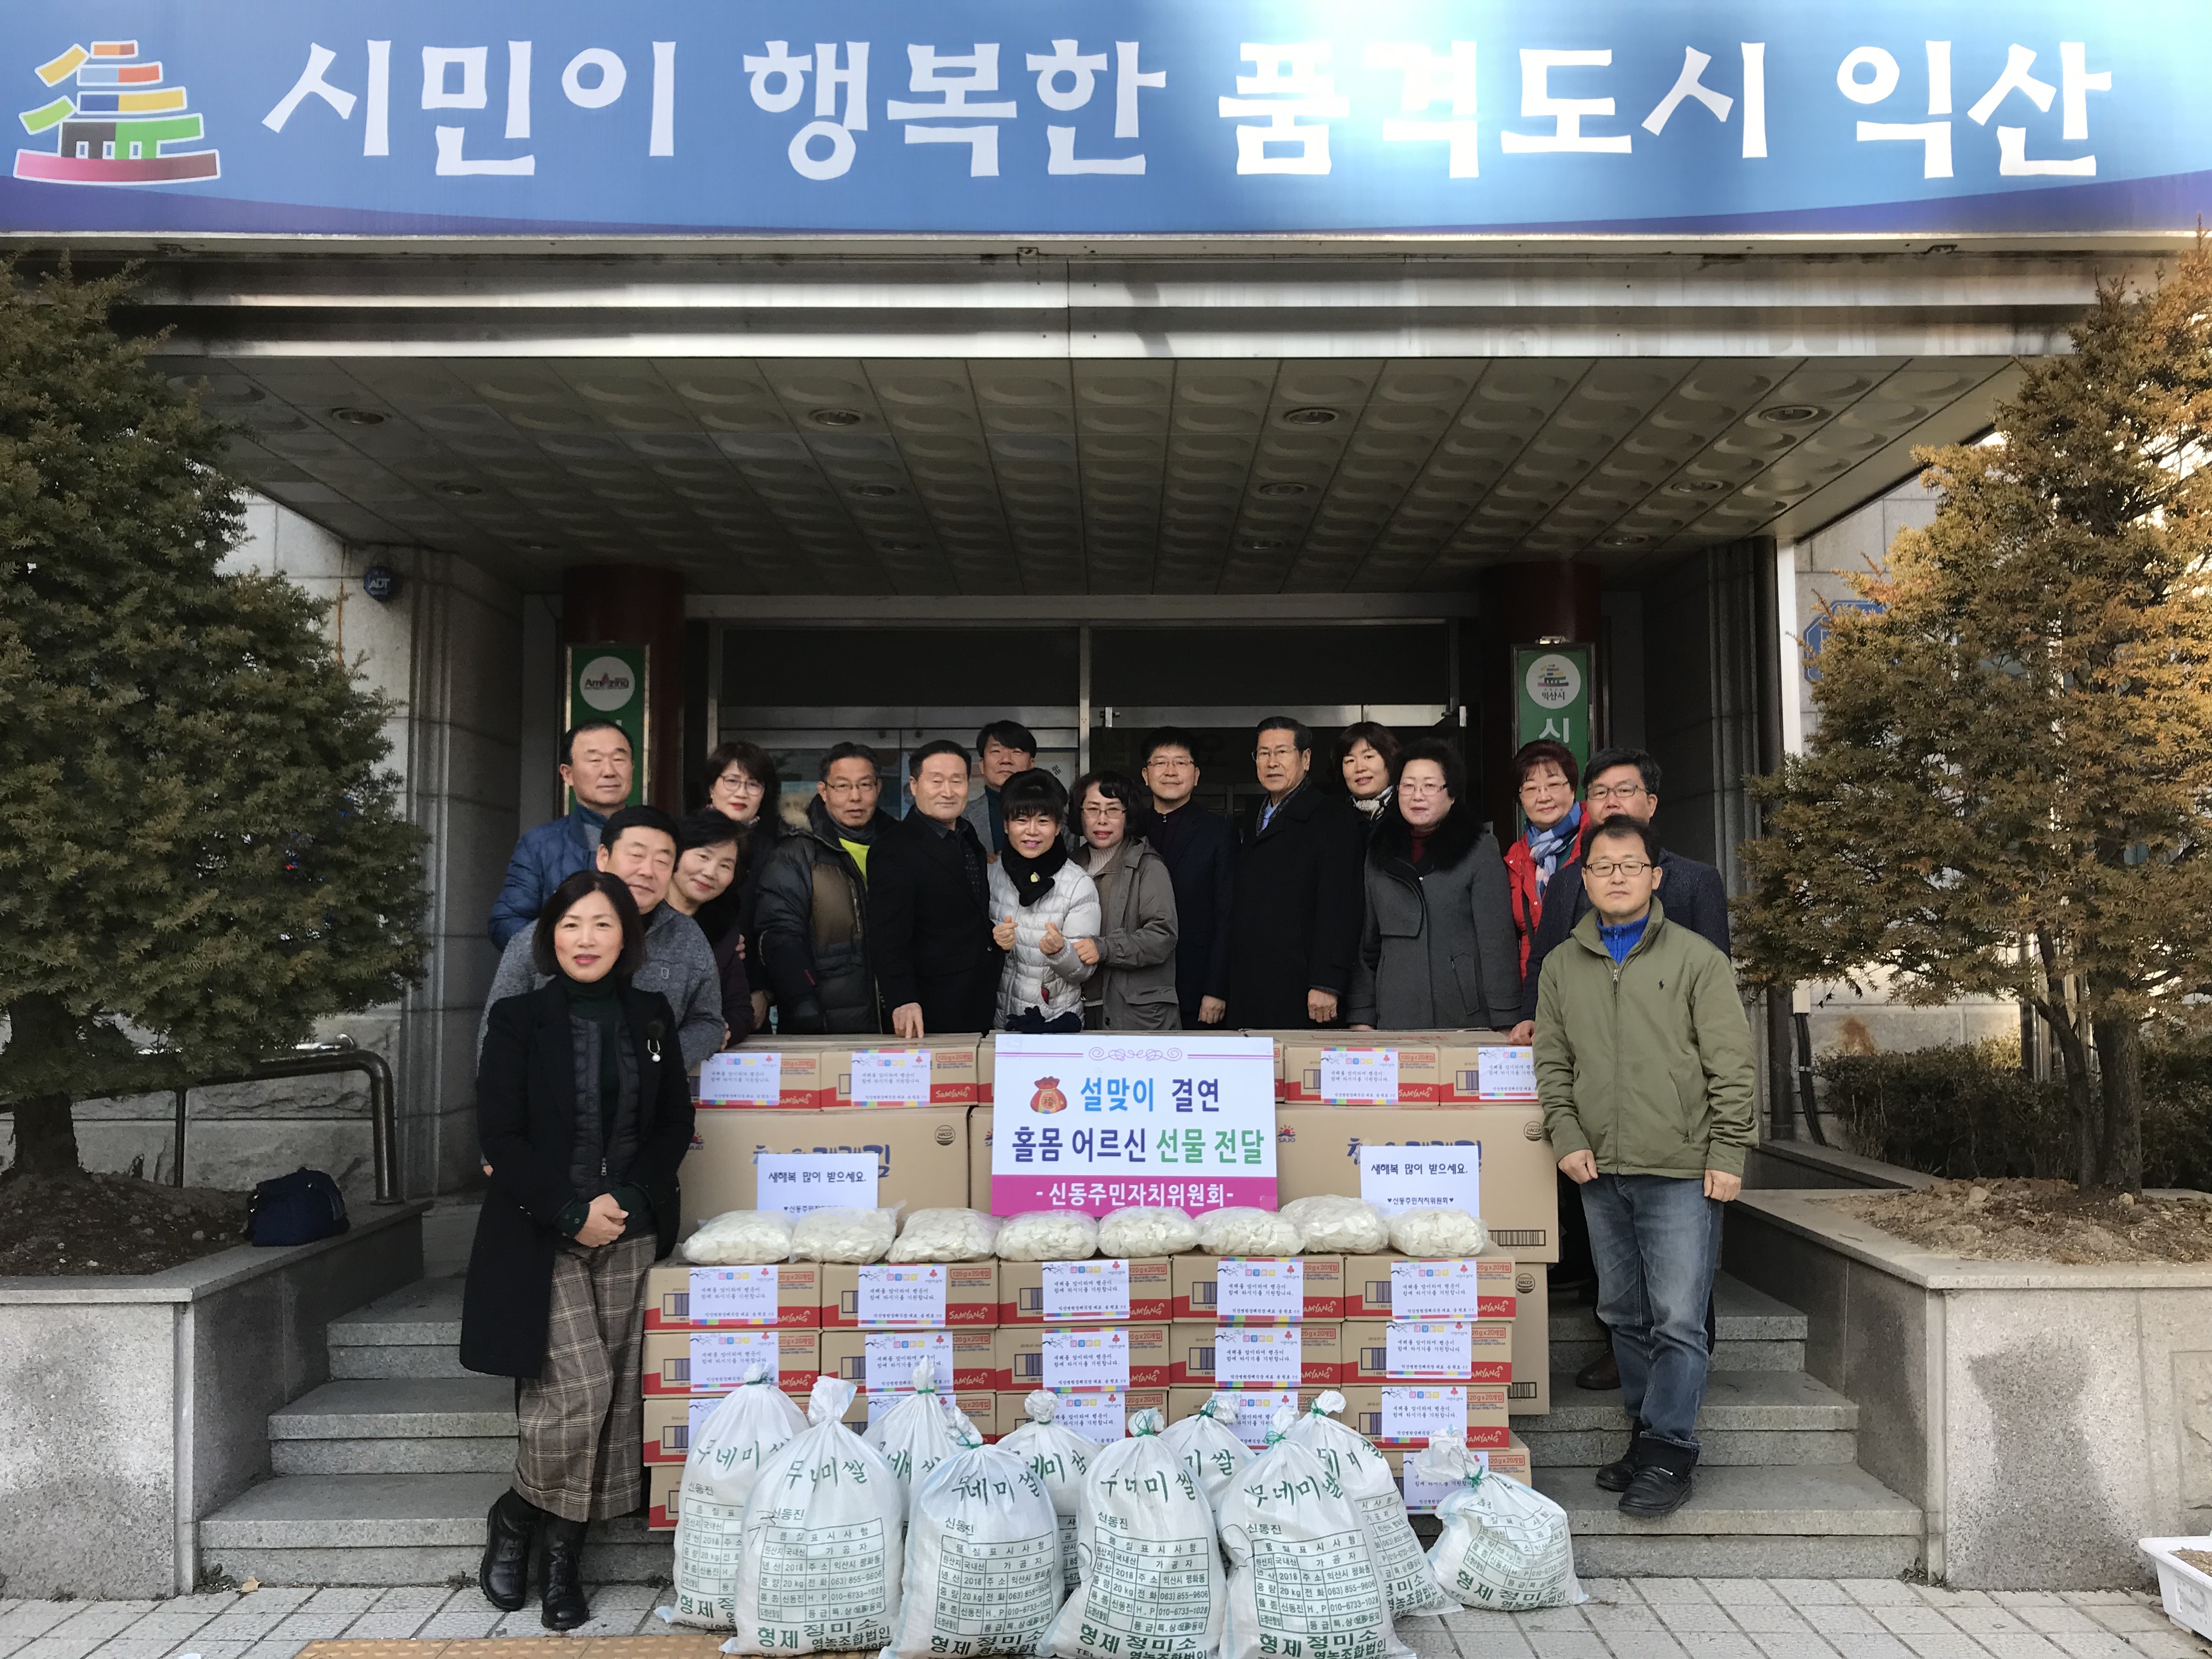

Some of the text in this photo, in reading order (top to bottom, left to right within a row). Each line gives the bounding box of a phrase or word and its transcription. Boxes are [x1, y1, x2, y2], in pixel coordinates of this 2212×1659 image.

[262, 40, 2112, 181] 시민이 행복한 품격도시 익산
[369, 578, 391, 589] ADT
[1542, 692, 1565, 701] 익산시
[935, 1088, 969, 1098] SAMYANG
[1080, 1077, 1220, 1113] 설맞이 결연
[1398, 1088, 1430, 1098] SAMYANG
[1012, 1126, 1265, 1165] 홀몸 어르신 선물 전달
[1371, 1164, 1468, 1175] 새해복 많이 받으세요.
[769, 1171, 867, 1183] 새해복 많이 받으세요.
[1392, 1197, 1448, 1205] 신동주민자치위원회
[1304, 1304, 1334, 1313] AMYANG
[1478, 1302, 1506, 1312] AMYANG
[949, 1310, 986, 1321] SAMYANG
[1301, 1369, 1330, 1379] AMYANG
[1471, 1368, 1500, 1378] AMYANG
[1098, 1511, 1128, 1530] 신동진
[945, 1517, 974, 1536] 신동진
[1247, 1523, 1282, 1535] 신동진
[834, 1560, 856, 1570] 익산시
[1116, 1554, 1136, 1566] 국내산
[1276, 1557, 1296, 1566] 국내산
[1489, 1556, 1509, 1572] 신동진
[964, 1561, 985, 1571] 국내산
[1327, 1569, 1348, 1579] 익산시
[1352, 1564, 1370, 1576] 평화동
[964, 1577, 981, 1585] 2018
[1115, 1568, 1205, 1585] 2018 익산시 평화동
[1160, 1593, 1175, 1601] 063)
[1177, 1590, 1208, 1599] 855-9606
[1328, 1585, 1343, 1595] 063)
[783, 1595, 804, 1604] 신동진
[1111, 1599, 1133, 1612] 신동진
[1282, 1602, 1304, 1613] 신동진
[961, 1607, 982, 1617] 신동진
[812, 1626, 890, 1650] 영농조합법인
